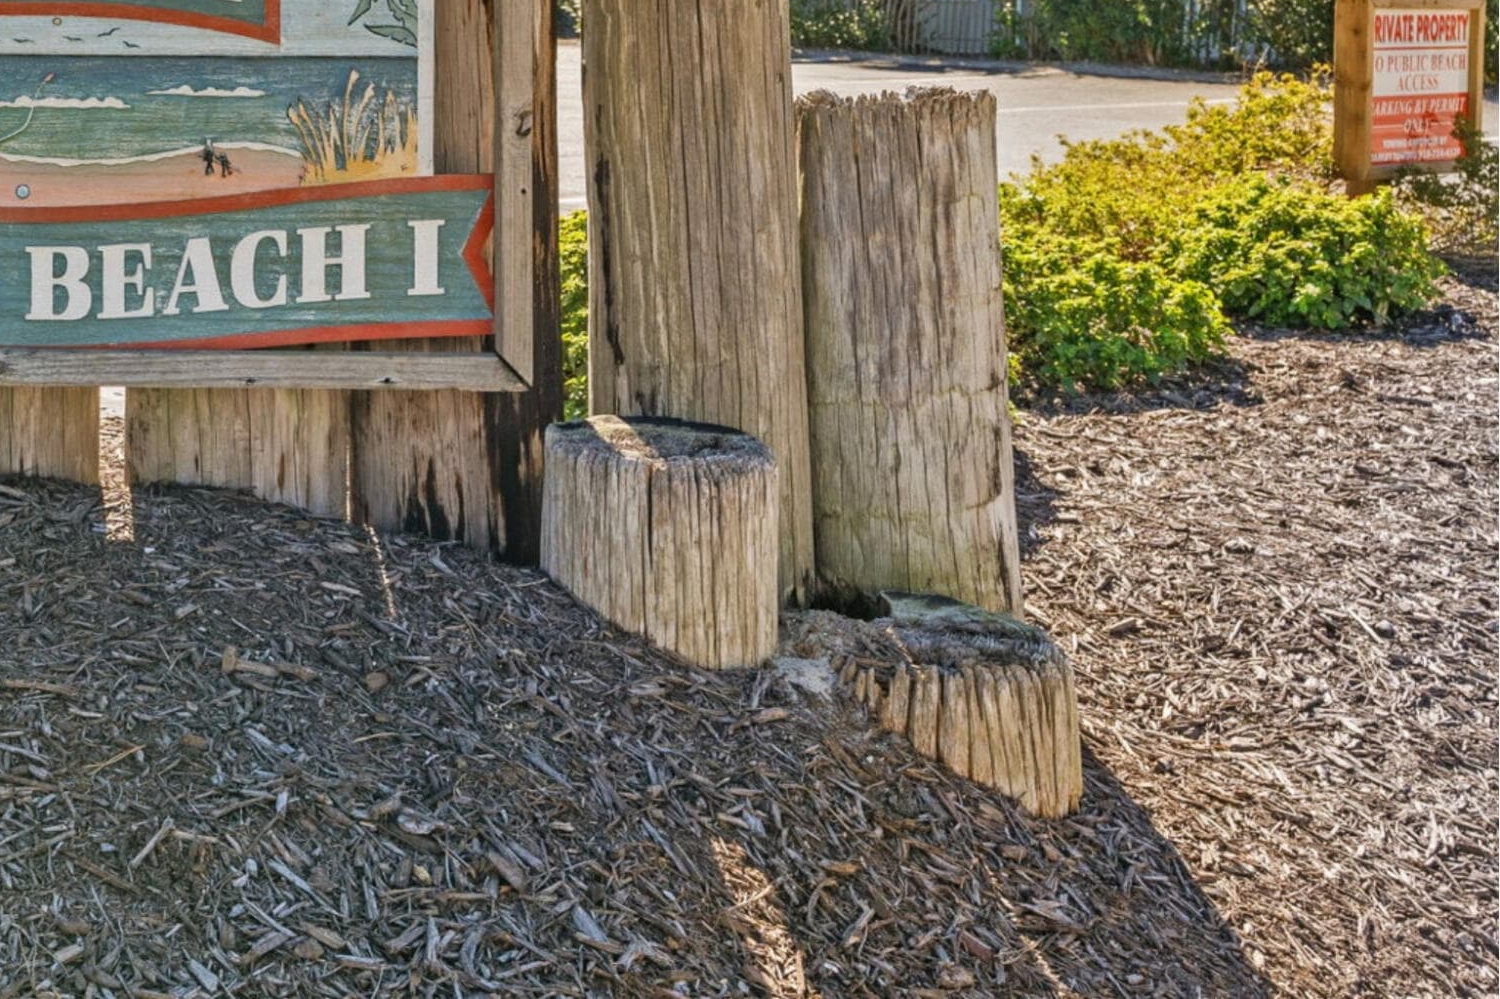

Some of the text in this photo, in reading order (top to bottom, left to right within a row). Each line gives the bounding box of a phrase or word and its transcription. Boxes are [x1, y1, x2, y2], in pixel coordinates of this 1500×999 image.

[1375, 13, 1468, 42] RIVATE PROPERTY
[1375, 53, 1466, 73] O PUBLIC BEACH
[1397, 73, 1439, 91] ACCESS
[1428, 95, 1467, 113] PERMIT
[1403, 117, 1430, 135] ONLY
[25, 223, 371, 321] BEACH
[407, 219, 445, 296] I
